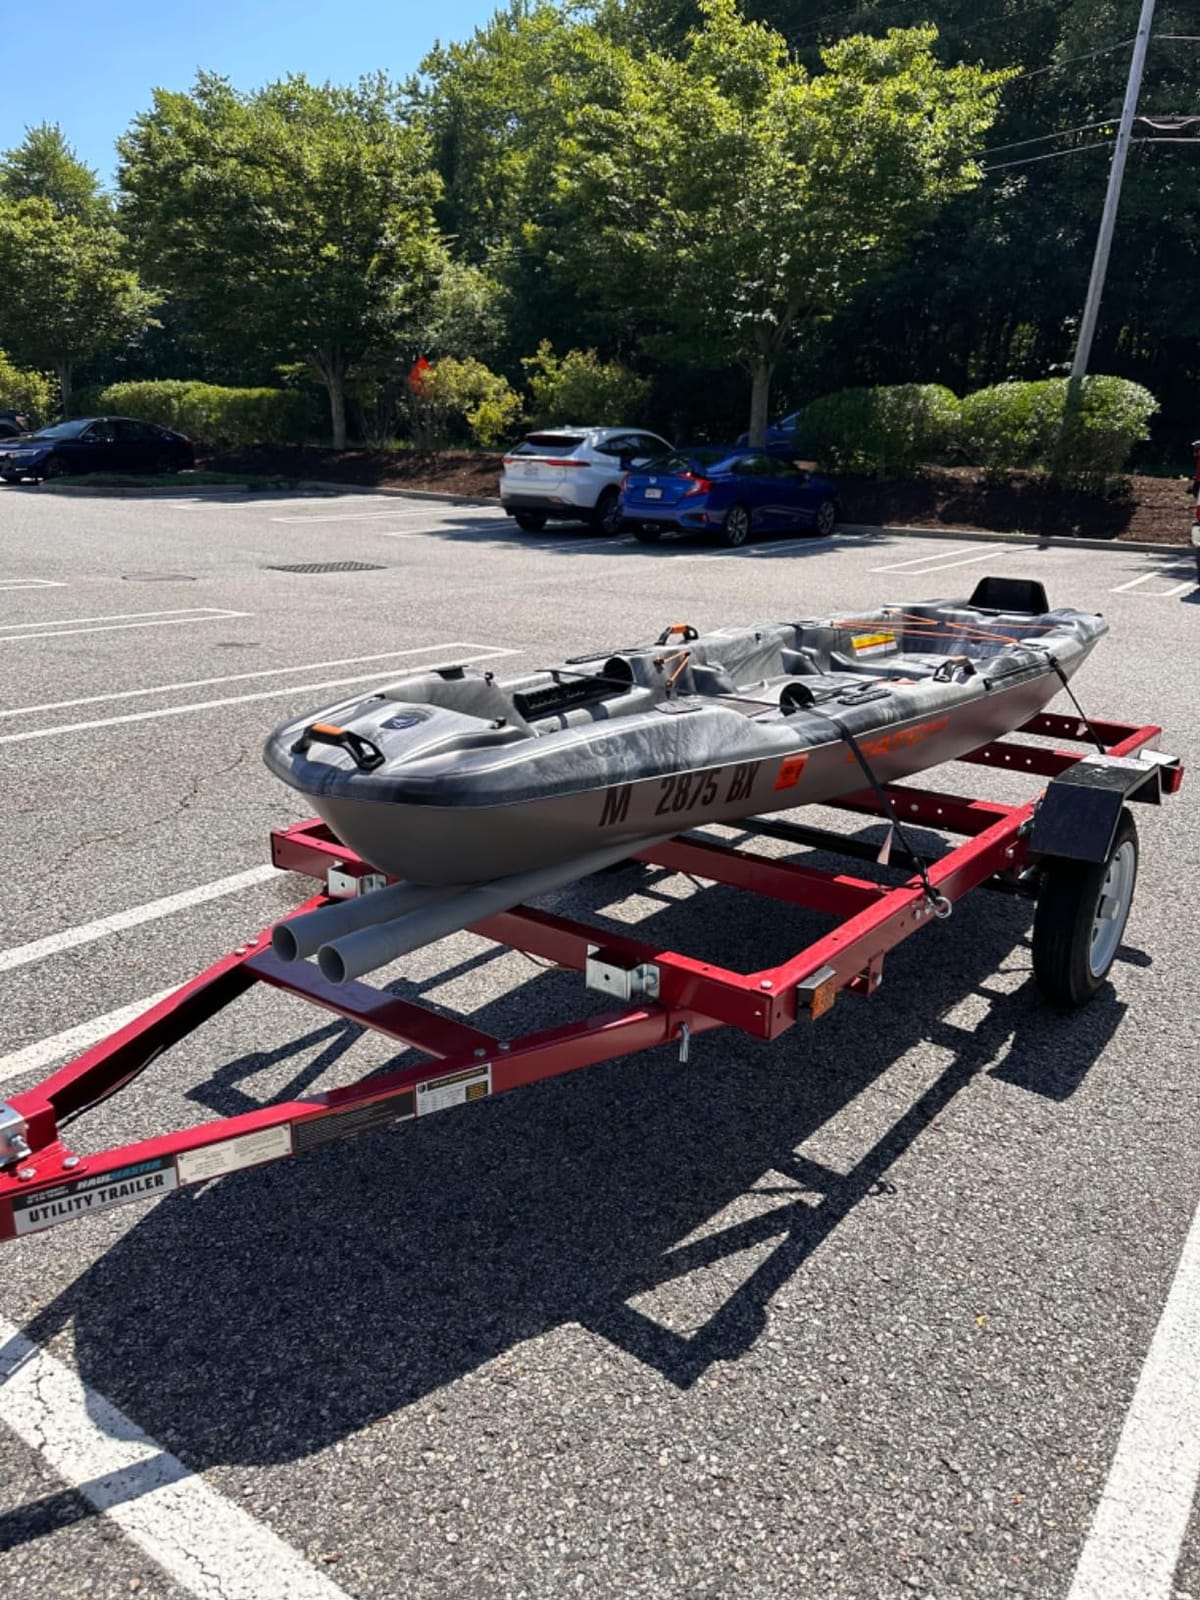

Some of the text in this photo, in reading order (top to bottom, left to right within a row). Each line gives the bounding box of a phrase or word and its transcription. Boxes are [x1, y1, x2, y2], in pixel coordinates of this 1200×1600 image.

[598, 783, 633, 827] M
[654, 767, 722, 816] 2875
[725, 760, 762, 804] BX
[29, 1193, 94, 1223] UTILITY
[99, 1174, 164, 1201] TRAILER
